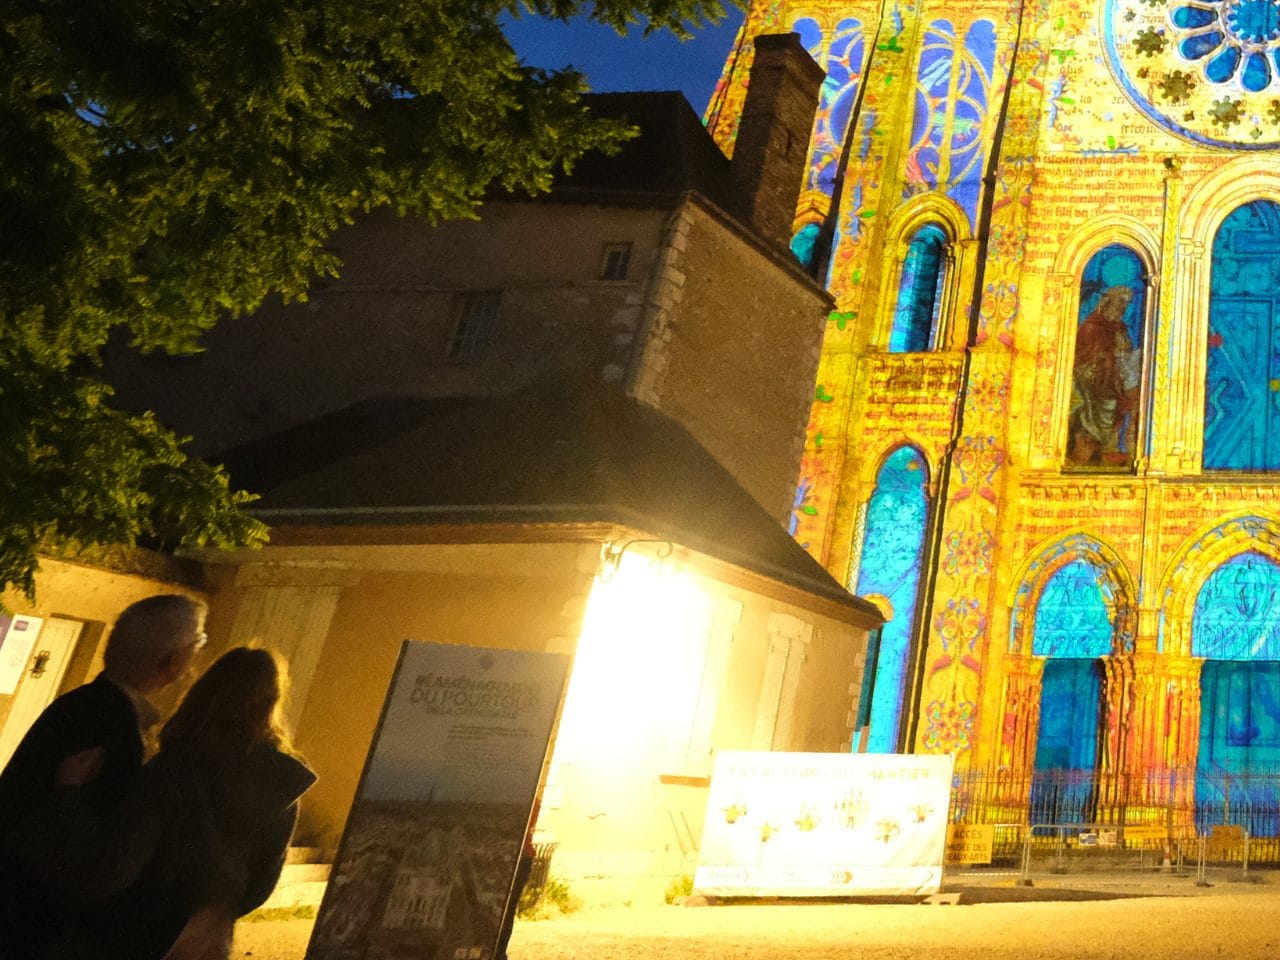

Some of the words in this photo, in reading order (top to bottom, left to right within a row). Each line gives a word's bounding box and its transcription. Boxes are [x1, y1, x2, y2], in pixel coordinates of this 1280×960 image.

[832, 767, 853, 779] DU
[857, 767, 930, 781] CHANTIER
[953, 828, 983, 839] ACCÈS
[947, 852, 988, 861] EAUX-ARTS
